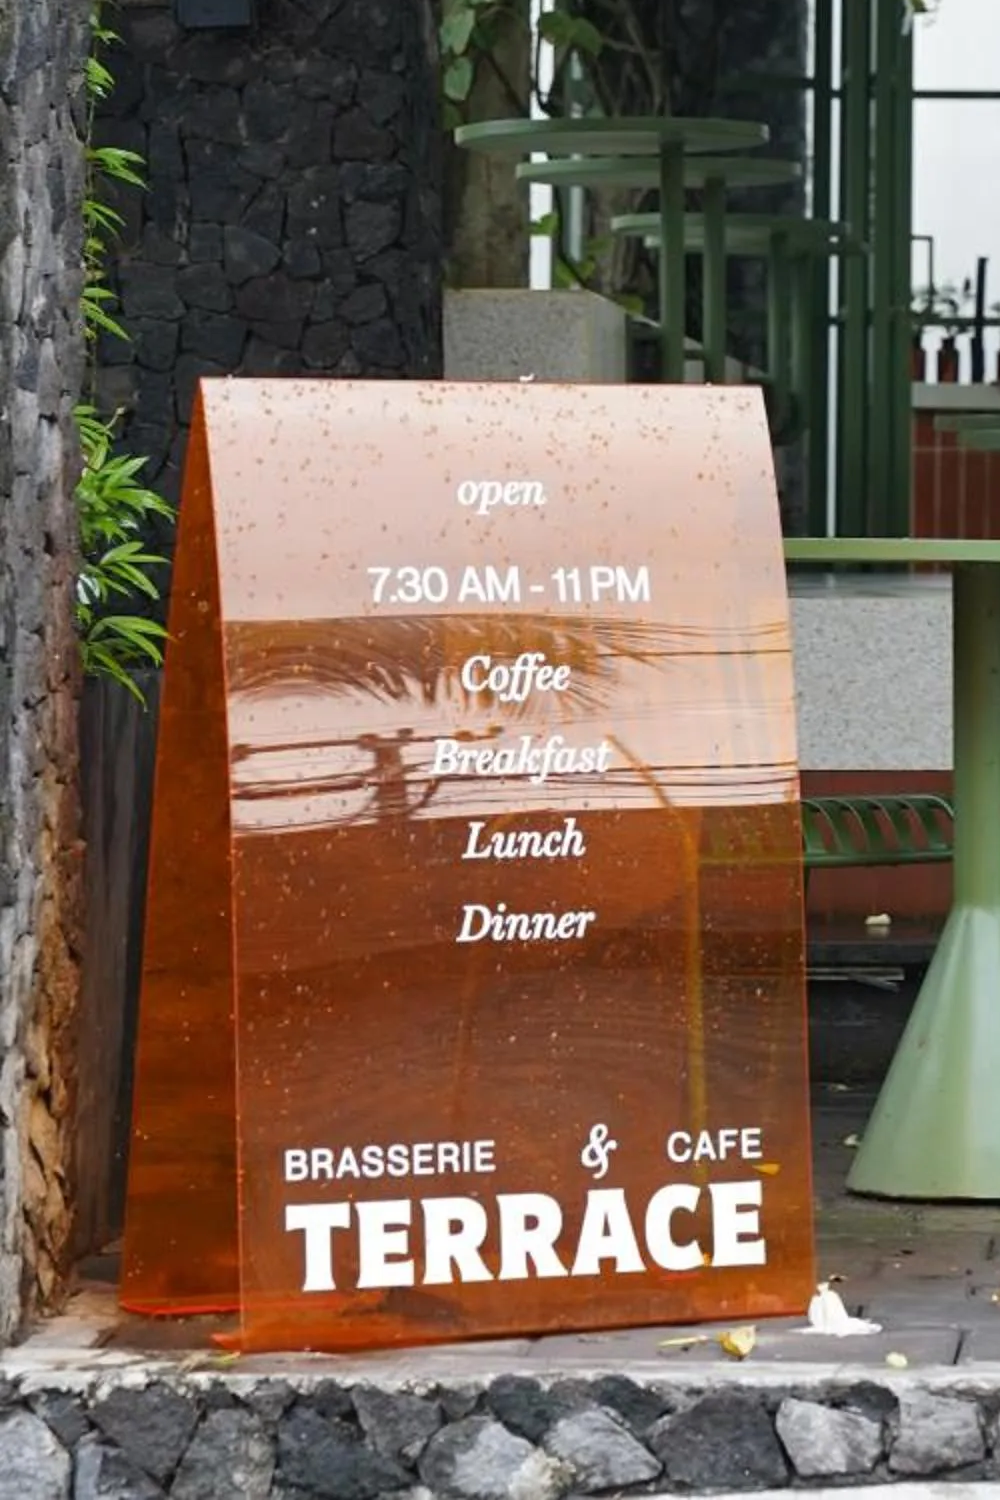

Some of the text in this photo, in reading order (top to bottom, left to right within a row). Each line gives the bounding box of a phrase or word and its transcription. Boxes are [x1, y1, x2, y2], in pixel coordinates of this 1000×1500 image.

[457, 480, 546, 515] open
[367, 566, 449, 602] 7.30
[457, 566, 520, 602] AM
[550, 567, 580, 601] 11
[591, 566, 650, 601] PM
[460, 653, 571, 702] Coffee
[428, 734, 613, 784] Breakfast
[460, 817, 586, 860] Lunch
[455, 903, 596, 943] Dinner
[285, 1122, 763, 1182] BRASSERIE & CAFE
[285, 1180, 767, 1293] TERRACE
